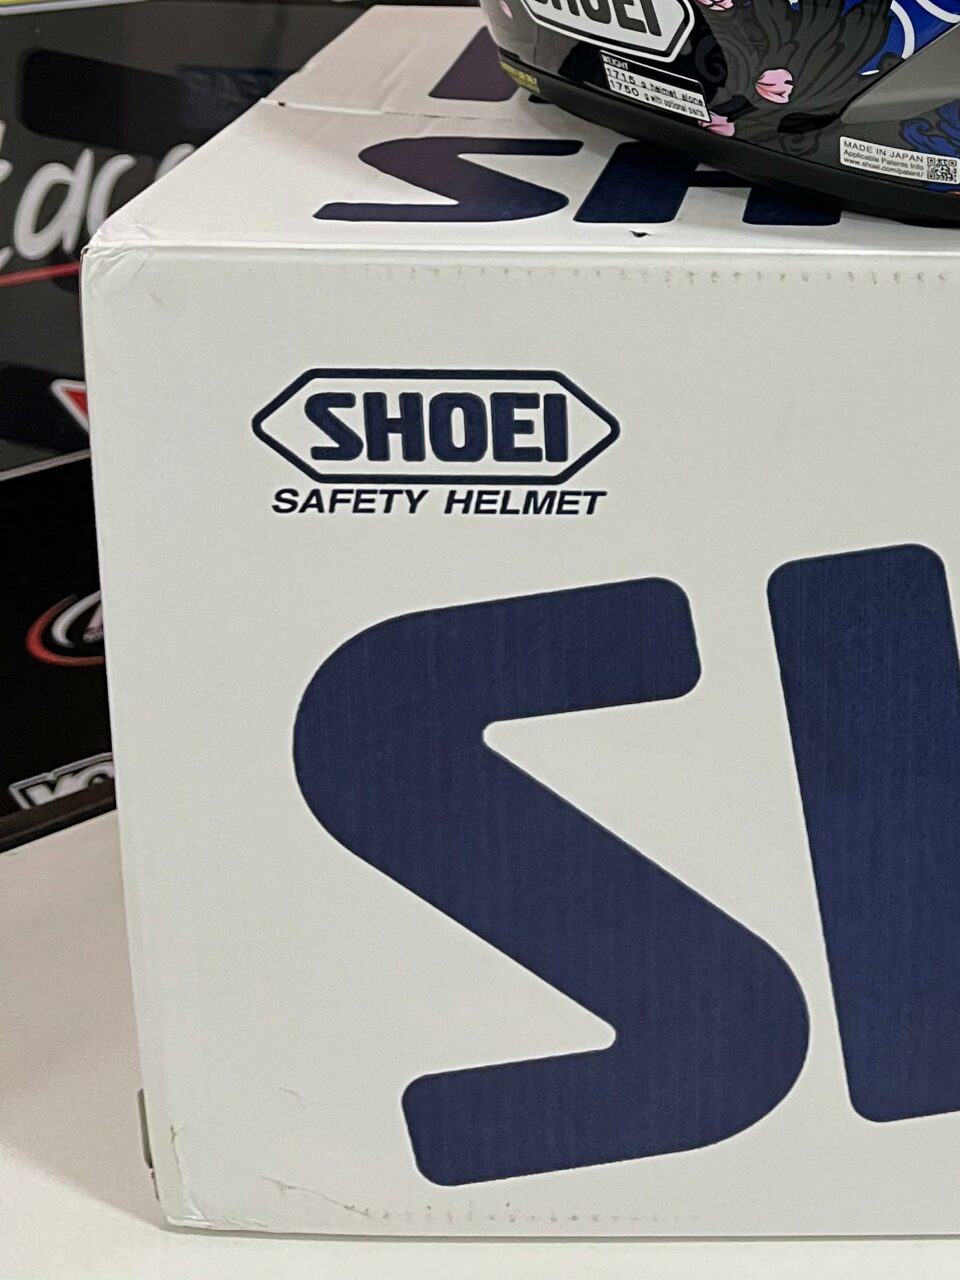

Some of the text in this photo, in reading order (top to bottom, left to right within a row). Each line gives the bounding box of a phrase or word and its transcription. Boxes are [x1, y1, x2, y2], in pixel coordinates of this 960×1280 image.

[606, 67, 636, 85] 1715
[650, 83, 678, 99] helmet
[610, 79, 640, 97] 1750
[843, 140, 924, 163] MADE IN JAPAN
[843, 149, 924, 171] Applicable Patents Info
[843, 157, 924, 177] www.shoei.com/patent/
[304, 391, 569, 462] SHOEI
[271, 488, 607, 515] SAFETY HELMET
